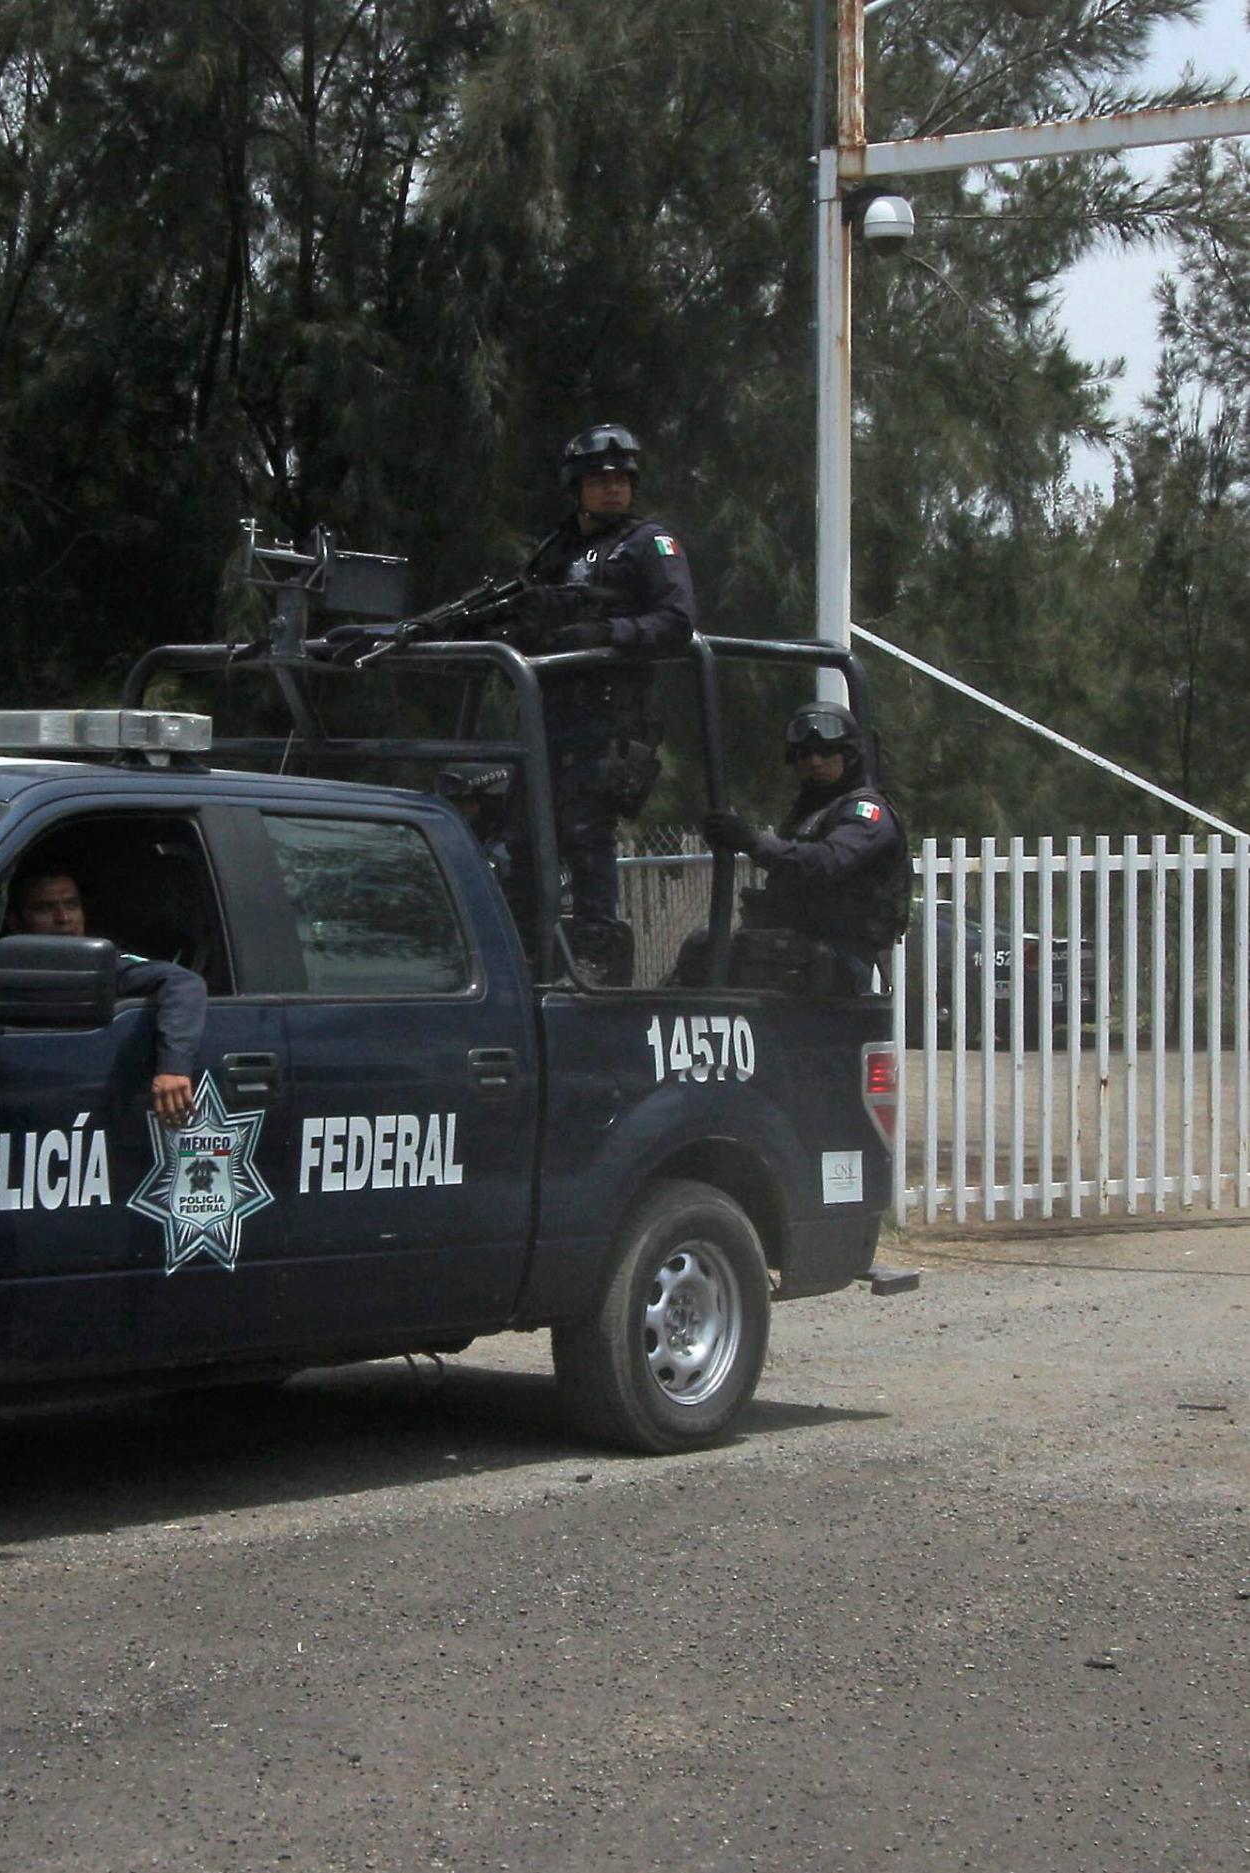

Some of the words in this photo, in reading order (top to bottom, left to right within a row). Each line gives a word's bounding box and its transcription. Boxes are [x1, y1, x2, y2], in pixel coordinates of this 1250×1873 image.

[647, 1015, 755, 1082] 14570
[299, 1113, 463, 1193] FEDERAL
[179, 1203, 226, 1214] FEDERAL
